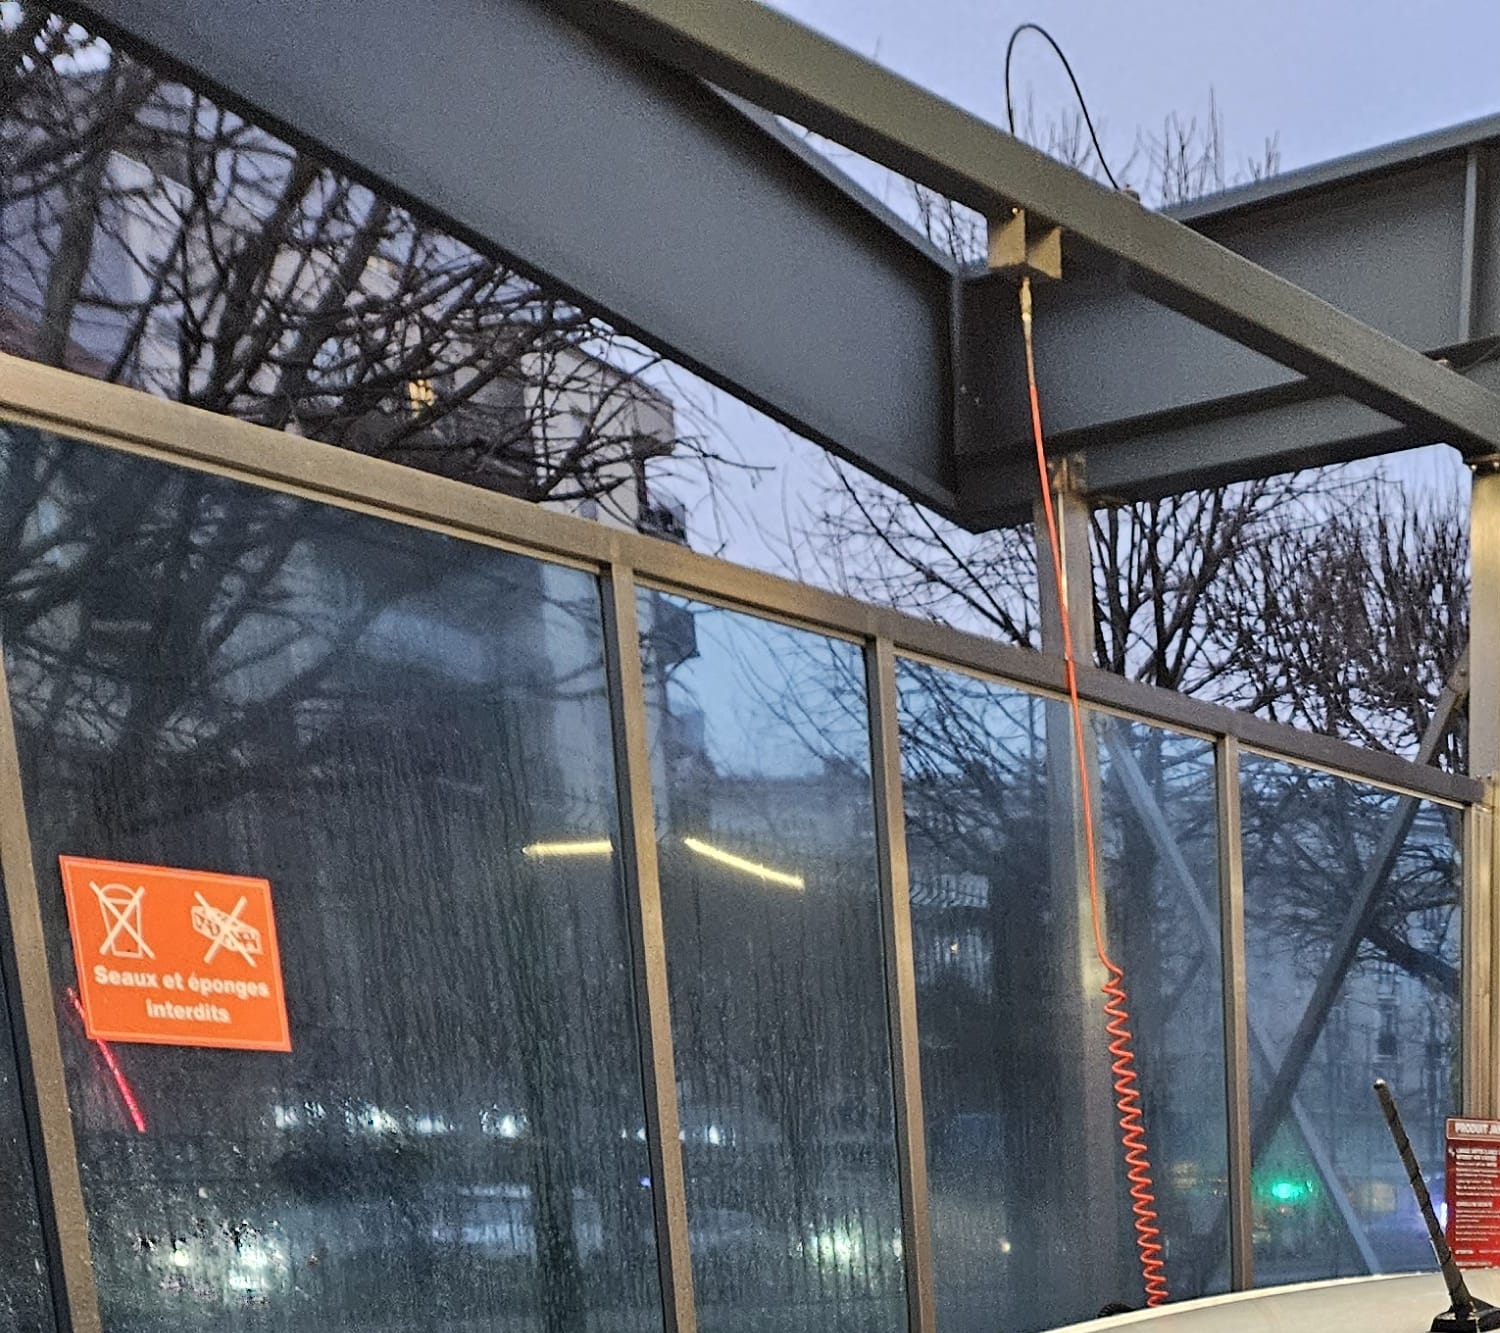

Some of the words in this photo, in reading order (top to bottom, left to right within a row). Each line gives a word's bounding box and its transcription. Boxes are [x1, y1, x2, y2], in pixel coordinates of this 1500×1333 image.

[94, 965, 159, 988] Seaux
[162, 972, 184, 992] et
[187, 972, 270, 999] éponges
